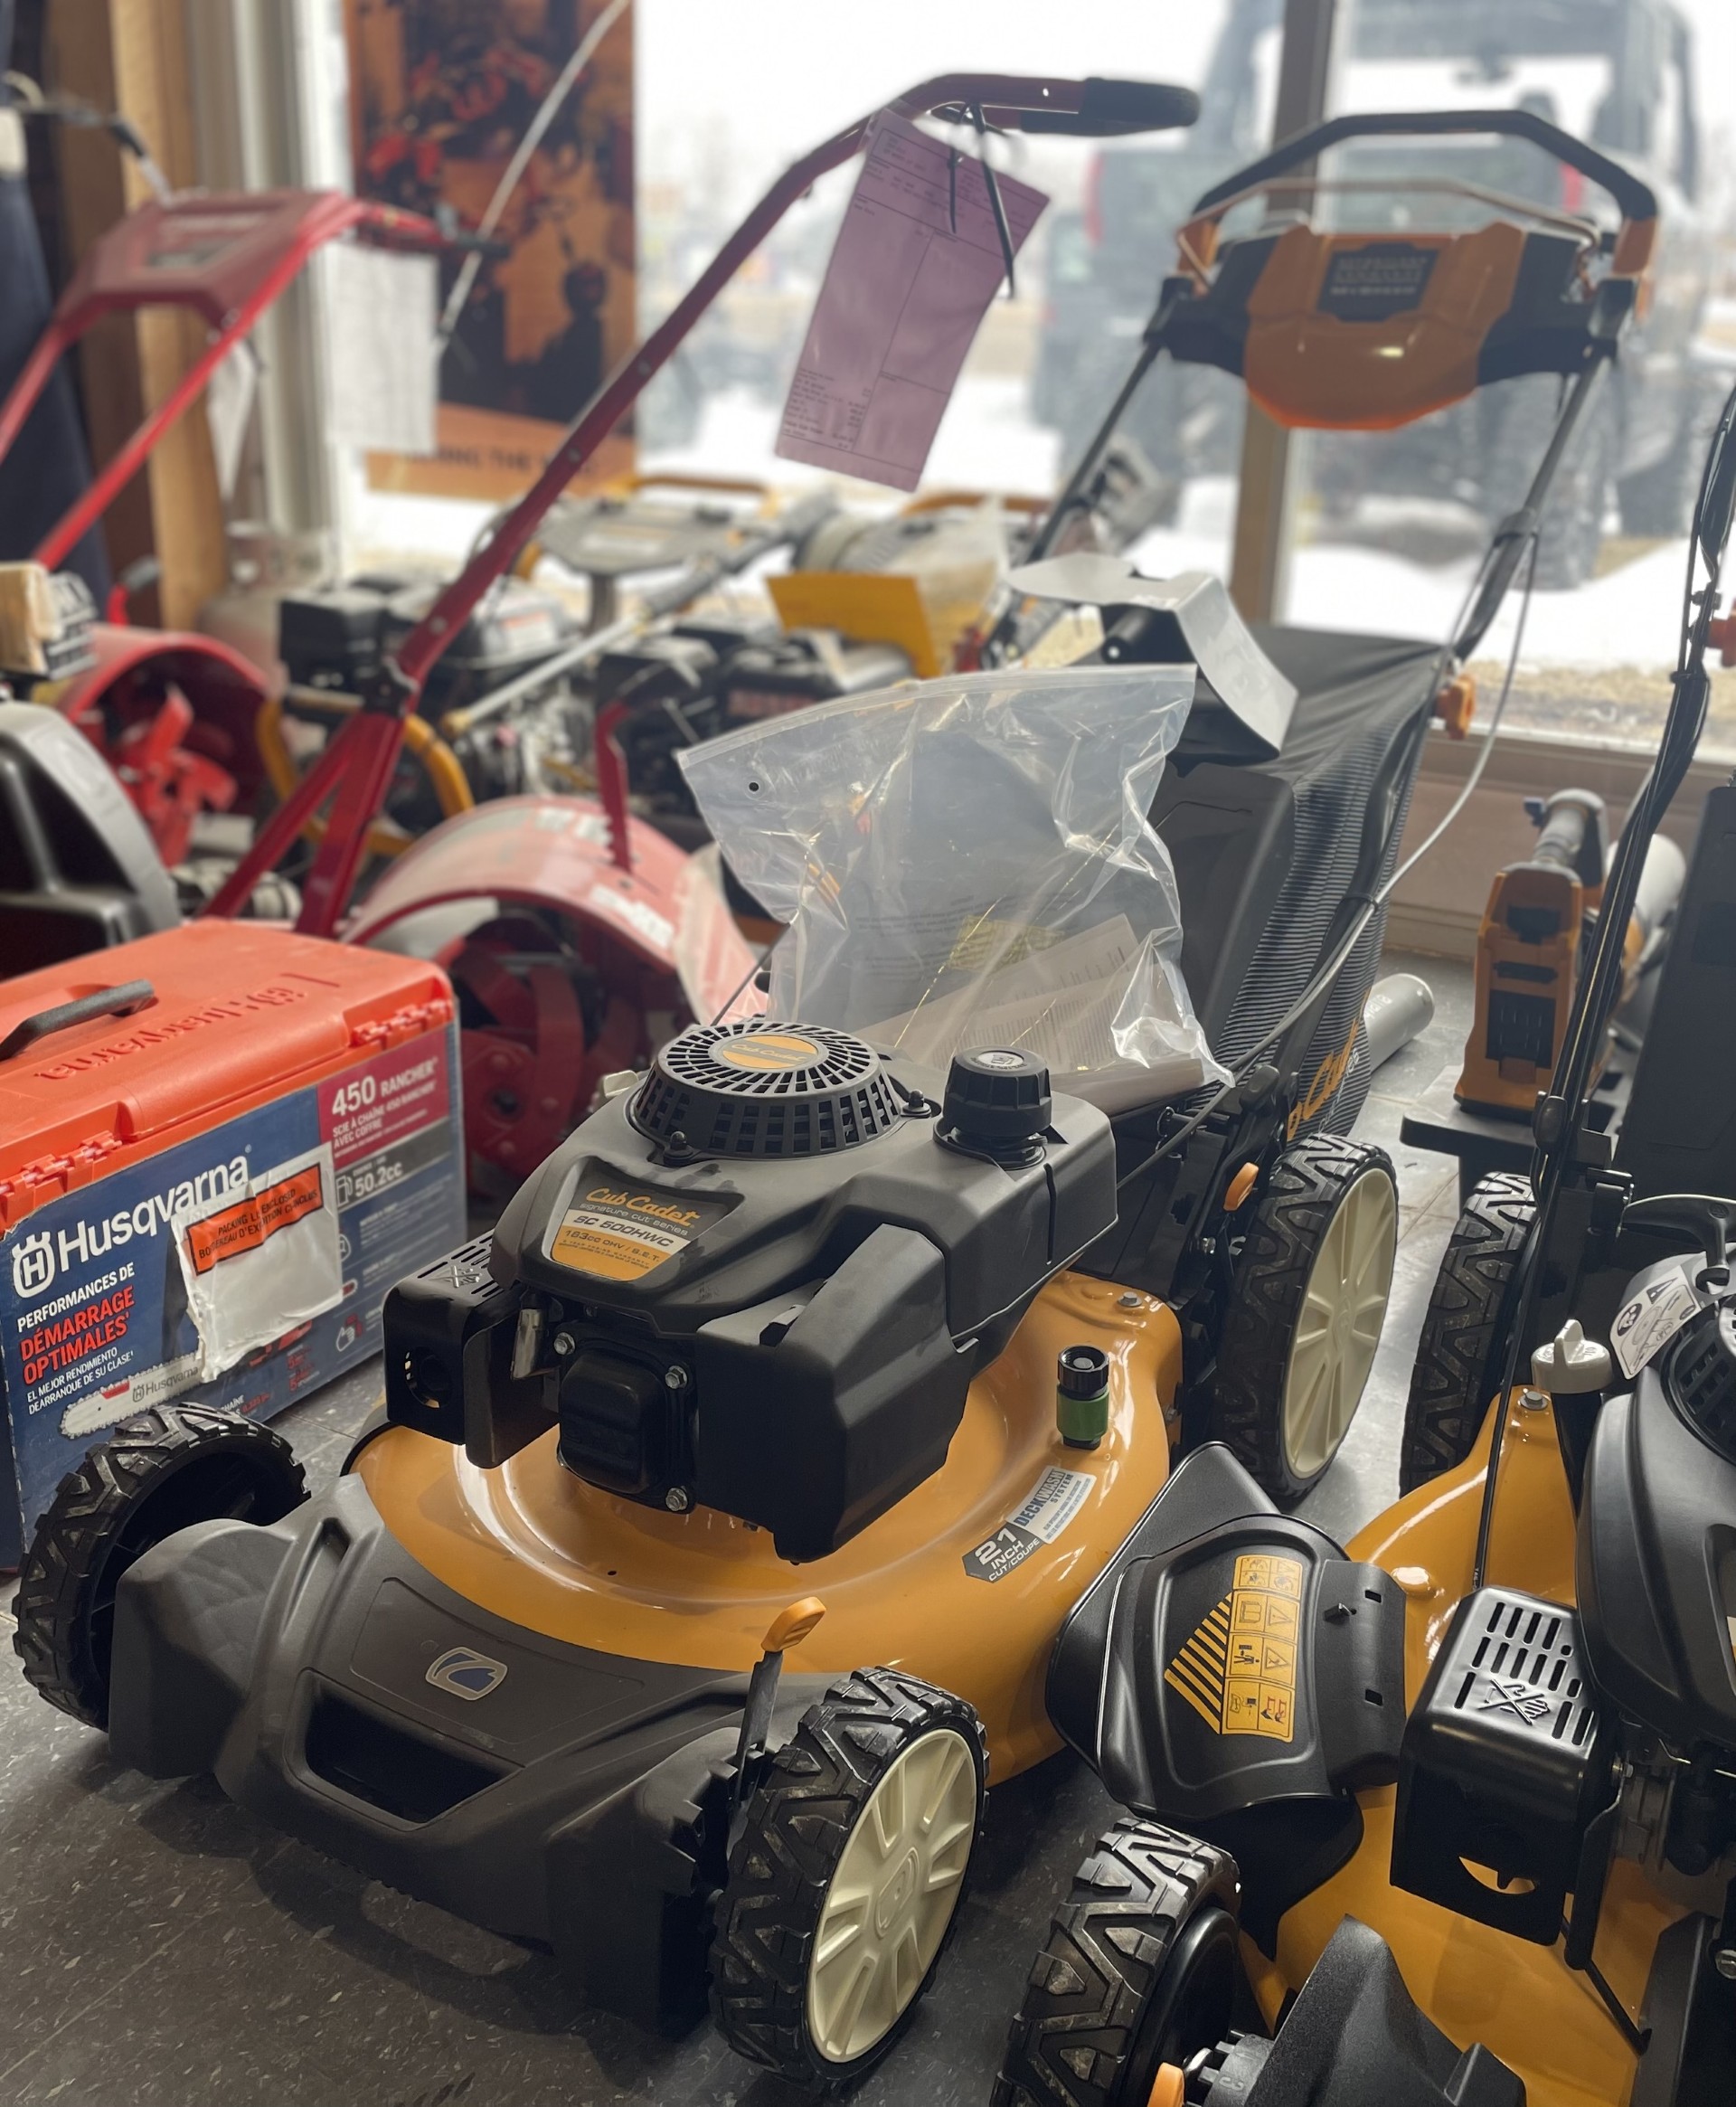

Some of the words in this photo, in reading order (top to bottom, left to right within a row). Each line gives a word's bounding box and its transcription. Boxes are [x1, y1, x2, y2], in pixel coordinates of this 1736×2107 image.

[332, 1075, 375, 1117] 450
[380, 1060, 435, 1097] RANCHER
[333, 1121, 350, 1138] SCIE
[334, 1133, 354, 1149] AVEC
[355, 1162, 402, 1198] 50.2cc
[58, 1156, 249, 1271] Husqvarna
[218, 1214, 249, 1235] PACKING
[261, 1188, 296, 1214] ENCLOSED
[573, 1215, 599, 1226] SC
[579, 1203, 629, 1217] signature
[631, 1213, 650, 1223] cut
[653, 1220, 689, 1236] series
[586, 1187, 629, 1206] Cub
[626, 1196, 702, 1227] Cadet
[17, 1273, 118, 1333] PERFORMANCES
[119, 1261, 135, 1281] DE
[20, 1285, 135, 1361] DÉMARRAGE
[27, 1391, 37, 1403] EL
[39, 1376, 65, 1397] MEJOR
[66, 1346, 118, 1382] RENDIMIENTO
[28, 1379, 83, 1415] DEARRANQUE
[84, 1373, 94, 1385] DE
[95, 1367, 107, 1380] SU
[146, 1366, 199, 1395] Husqvarna
[1050, 1473, 1074, 1504] SYSTEM
[975, 1527, 1017, 1565] 21
[988, 1538, 1040, 1582] CUT/COUPE
[990, 1540, 1024, 1570] INCH
